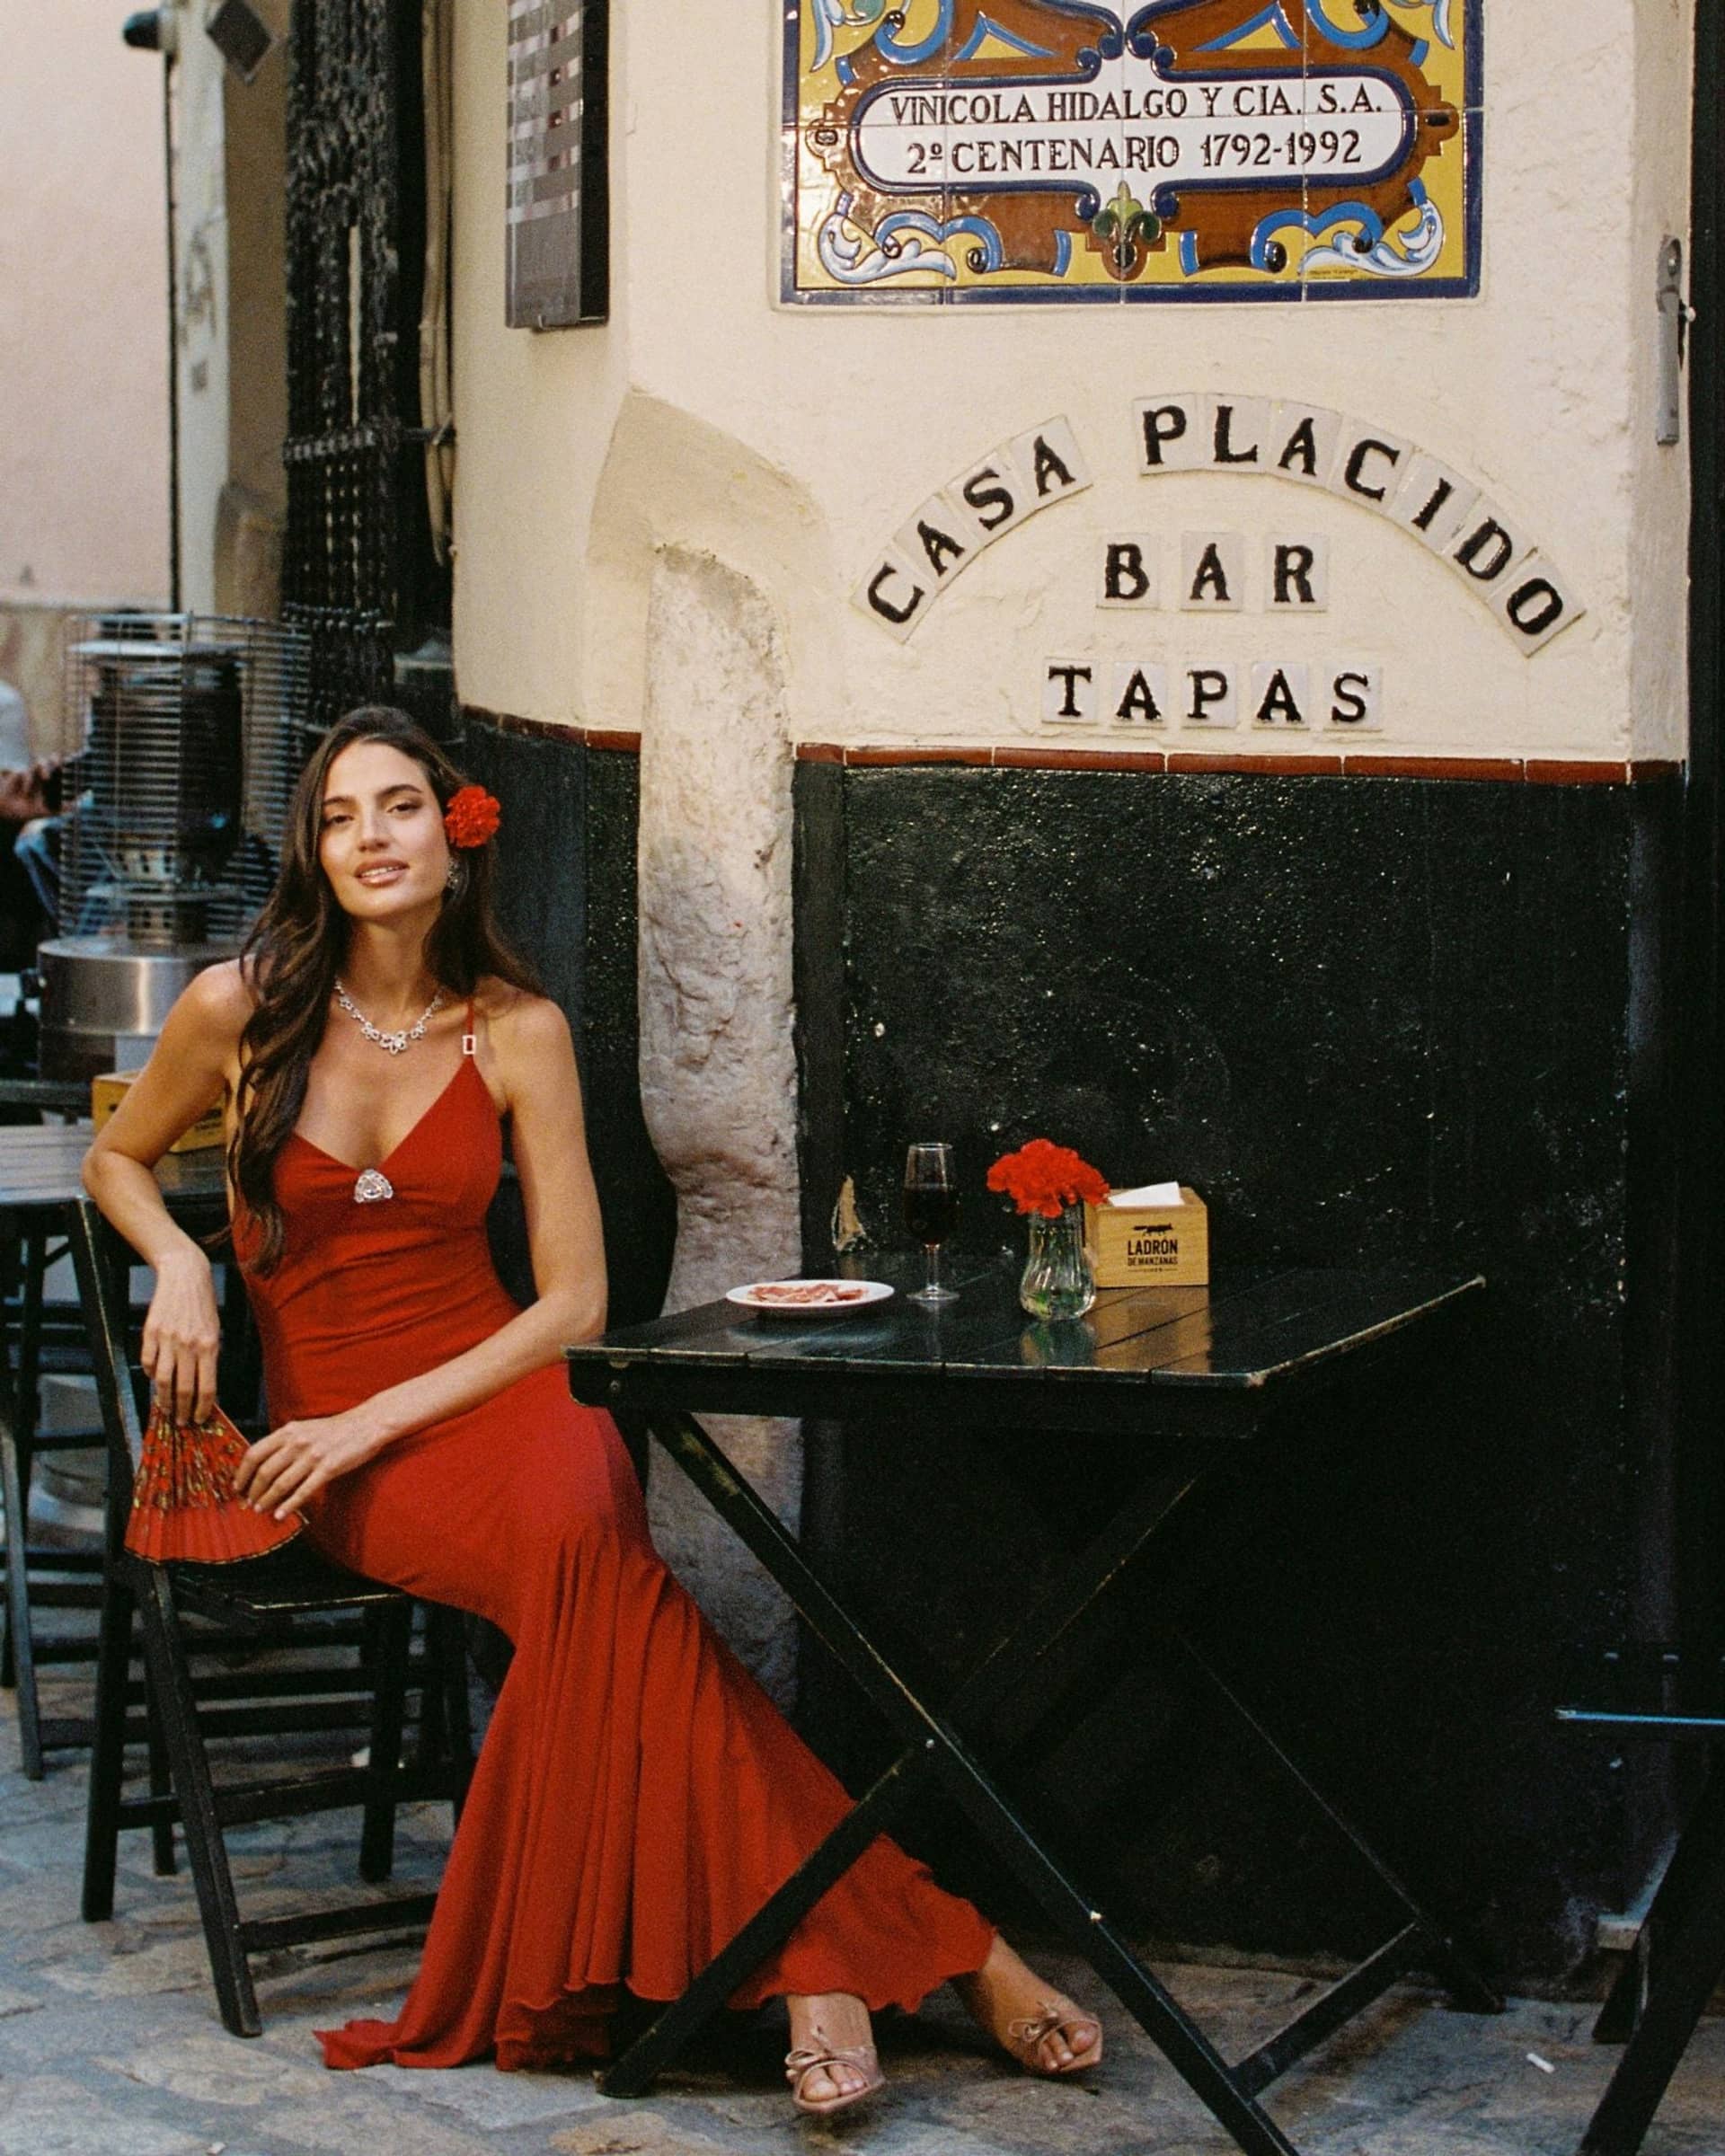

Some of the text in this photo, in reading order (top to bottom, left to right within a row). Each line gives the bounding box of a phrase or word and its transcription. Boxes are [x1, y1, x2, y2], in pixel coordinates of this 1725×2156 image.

[889, 83, 1382, 125] VINICOLA HIDALGO Y CIA. S.A.
[951, 136, 1180, 172] CENTENARIO
[1199, 128, 1362, 167] 1792-1992
[866, 404, 1564, 636] CASA PLACIDO
[1104, 543, 1315, 604] BAR
[1048, 665, 1368, 724] TAPAS
